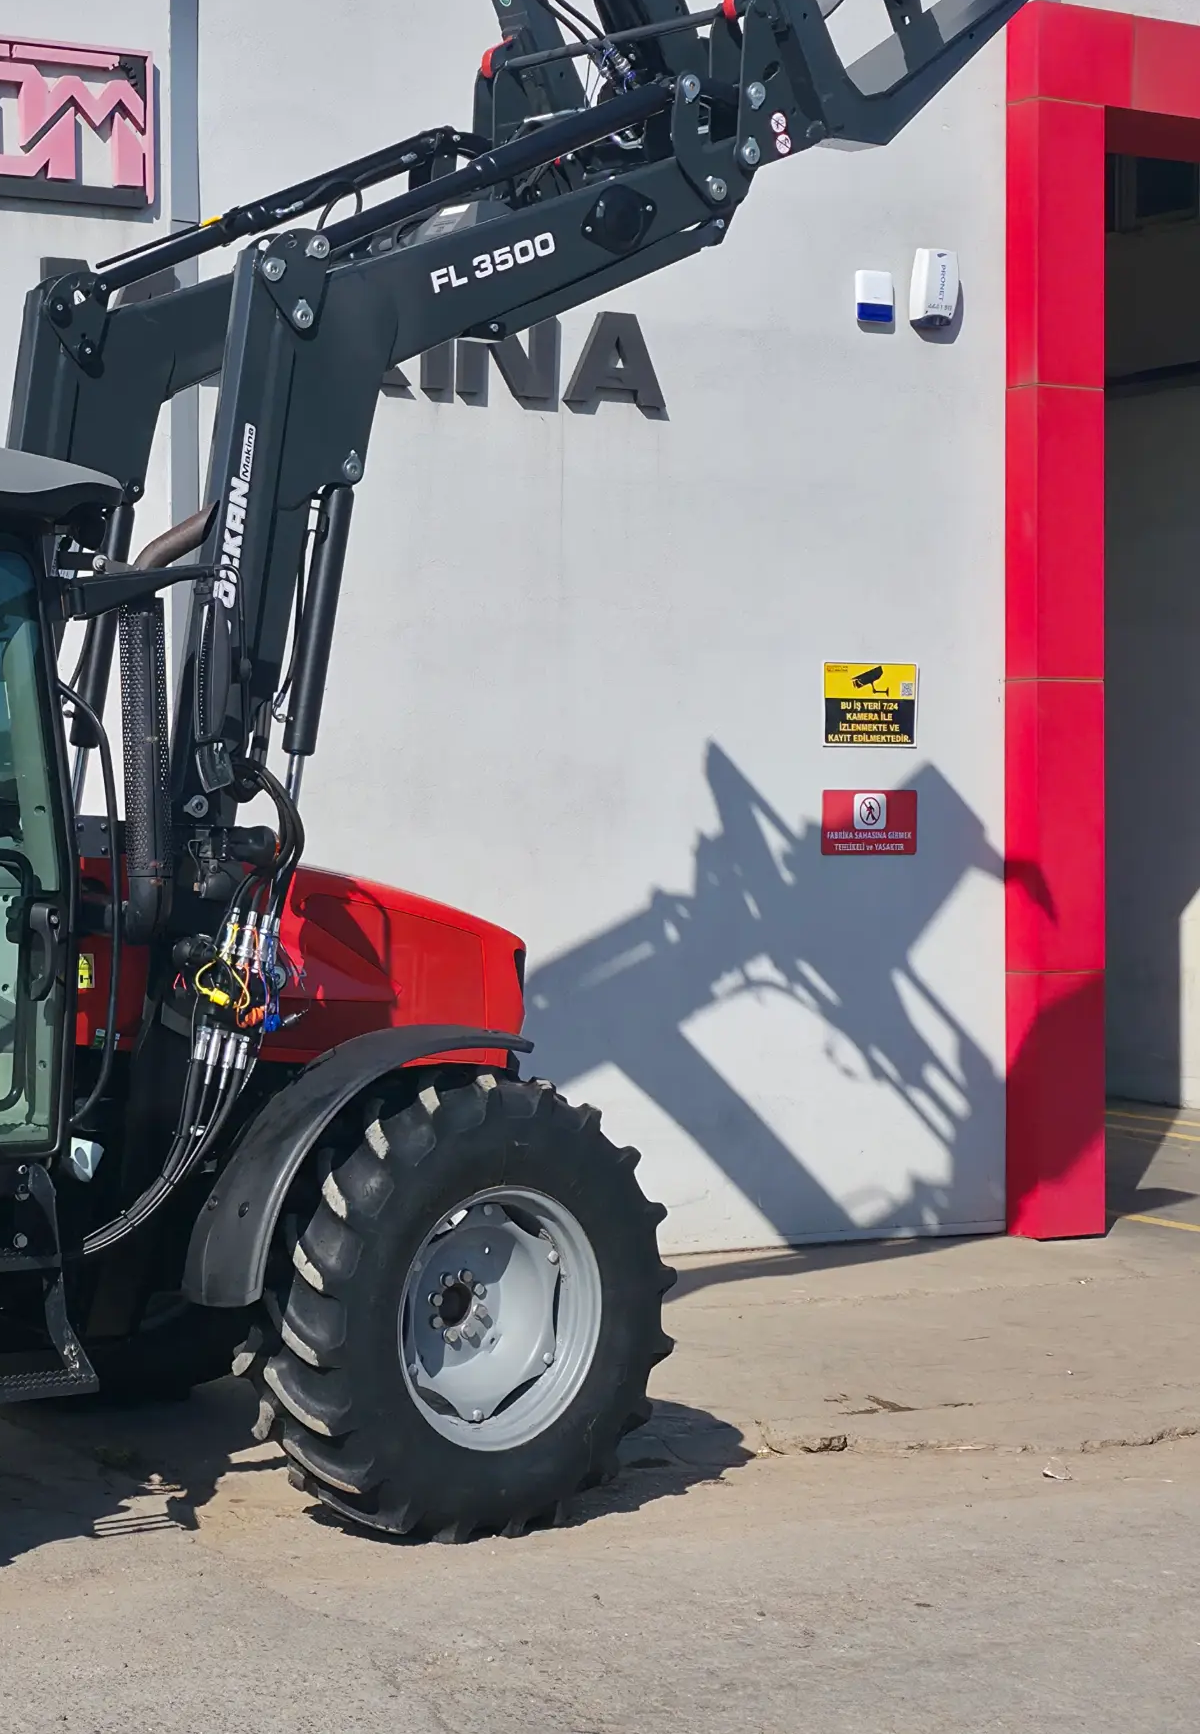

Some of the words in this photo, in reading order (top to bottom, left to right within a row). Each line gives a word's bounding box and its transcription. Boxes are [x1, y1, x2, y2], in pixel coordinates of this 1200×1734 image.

[430, 265, 468, 294] FL
[472, 231, 556, 279] 3500
[938, 264, 946, 301] PRONET
[241, 426, 256, 479] Makina
[840, 701, 852, 710] BU
[853, 700, 861, 711] İŞ
[863, 700, 880, 710] YERİ
[846, 712, 879, 721] KAMERA
[880, 711, 893, 721] İLE
[839, 722, 888, 732] İZLENMEKTE
[889, 724, 900, 732] VE
[828, 734, 851, 742] KAYIT
[853, 733, 911, 743] EDİLMEKTEDİR.
